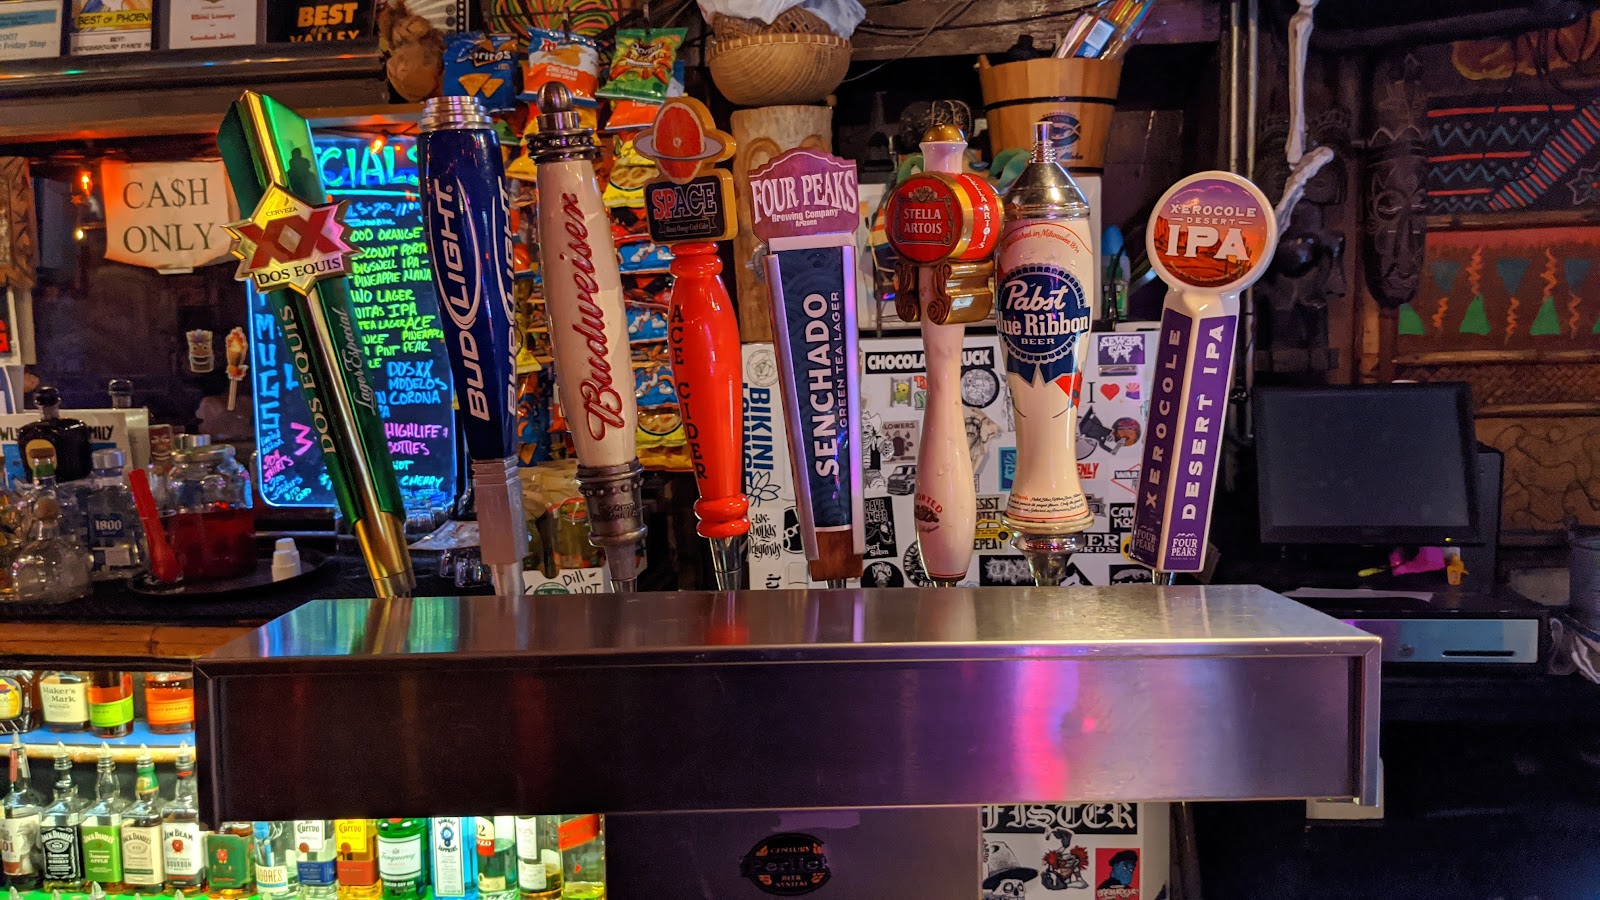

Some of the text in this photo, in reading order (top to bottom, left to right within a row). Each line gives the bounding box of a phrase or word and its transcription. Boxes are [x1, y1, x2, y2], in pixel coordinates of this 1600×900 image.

[78, 15, 102, 26] BEST
[298, 2, 358, 28] BEST
[123, 178, 210, 209] CA$H
[651, 182, 718, 221] SPACE
[750, 169, 858, 225] FOUR PEAKS
[265, 206, 299, 218] CERVEZA
[771, 207, 839, 224] Brewing Company
[903, 208, 942, 220] STELLA
[1169, 203, 1257, 218] XEROCOLE
[795, 218, 818, 228] Arizona
[903, 222, 943, 235] ARTOIS
[978, 204, 992, 249] ARTOIS
[1186, 216, 1236, 226] DESERT
[123, 222, 214, 254] ONLY
[377, 226, 424, 241] ORANGE
[1164, 223, 1250, 261] IPA
[257, 256, 342, 286] DOS EQUIS
[376, 288, 416, 304] LAGER
[1004, 279, 1070, 312] Pabst
[387, 301, 418, 318] IPA
[561, 191, 626, 442] Budweiser
[1023, 312, 1089, 337] Ribbon
[670, 304, 685, 366] ACE
[1020, 337, 1056, 346] BEER
[279, 304, 318, 390] EQUIS
[402, 340, 431, 354] PEAR
[830, 291, 848, 429] GREEN TEA LAGER
[961, 349, 992, 367] UCK
[458, 328, 491, 422] BUD
[802, 292, 841, 478] SENCHADO
[1087, 381, 1096, 404] I
[388, 389, 442, 406] CORONA
[308, 397, 336, 455] DOS
[882, 422, 916, 430] LOWERS
[1145, 329, 1181, 508] XEROCOLE
[1181, 324, 1225, 521] DESERT IPA
[677, 381, 709, 480] CIDER
[749, 387, 775, 471] BIKINI
[95, 520, 122, 531] 1800
[1083, 533, 1119, 548] ER
[1172, 538, 1198, 549] FOUR
[1170, 547, 1198, 557] PEAKS
[562, 569, 585, 587] Dill
[573, 583, 602, 595] HOT
[42, 686, 76, 695] Maker's
[51, 695, 77, 703] Mark
[163, 828, 194, 842] JIM BEAM
[296, 822, 320, 834] Cuervo
[338, 822, 362, 834] Cuervo
[166, 860, 192, 868] BOURBON
